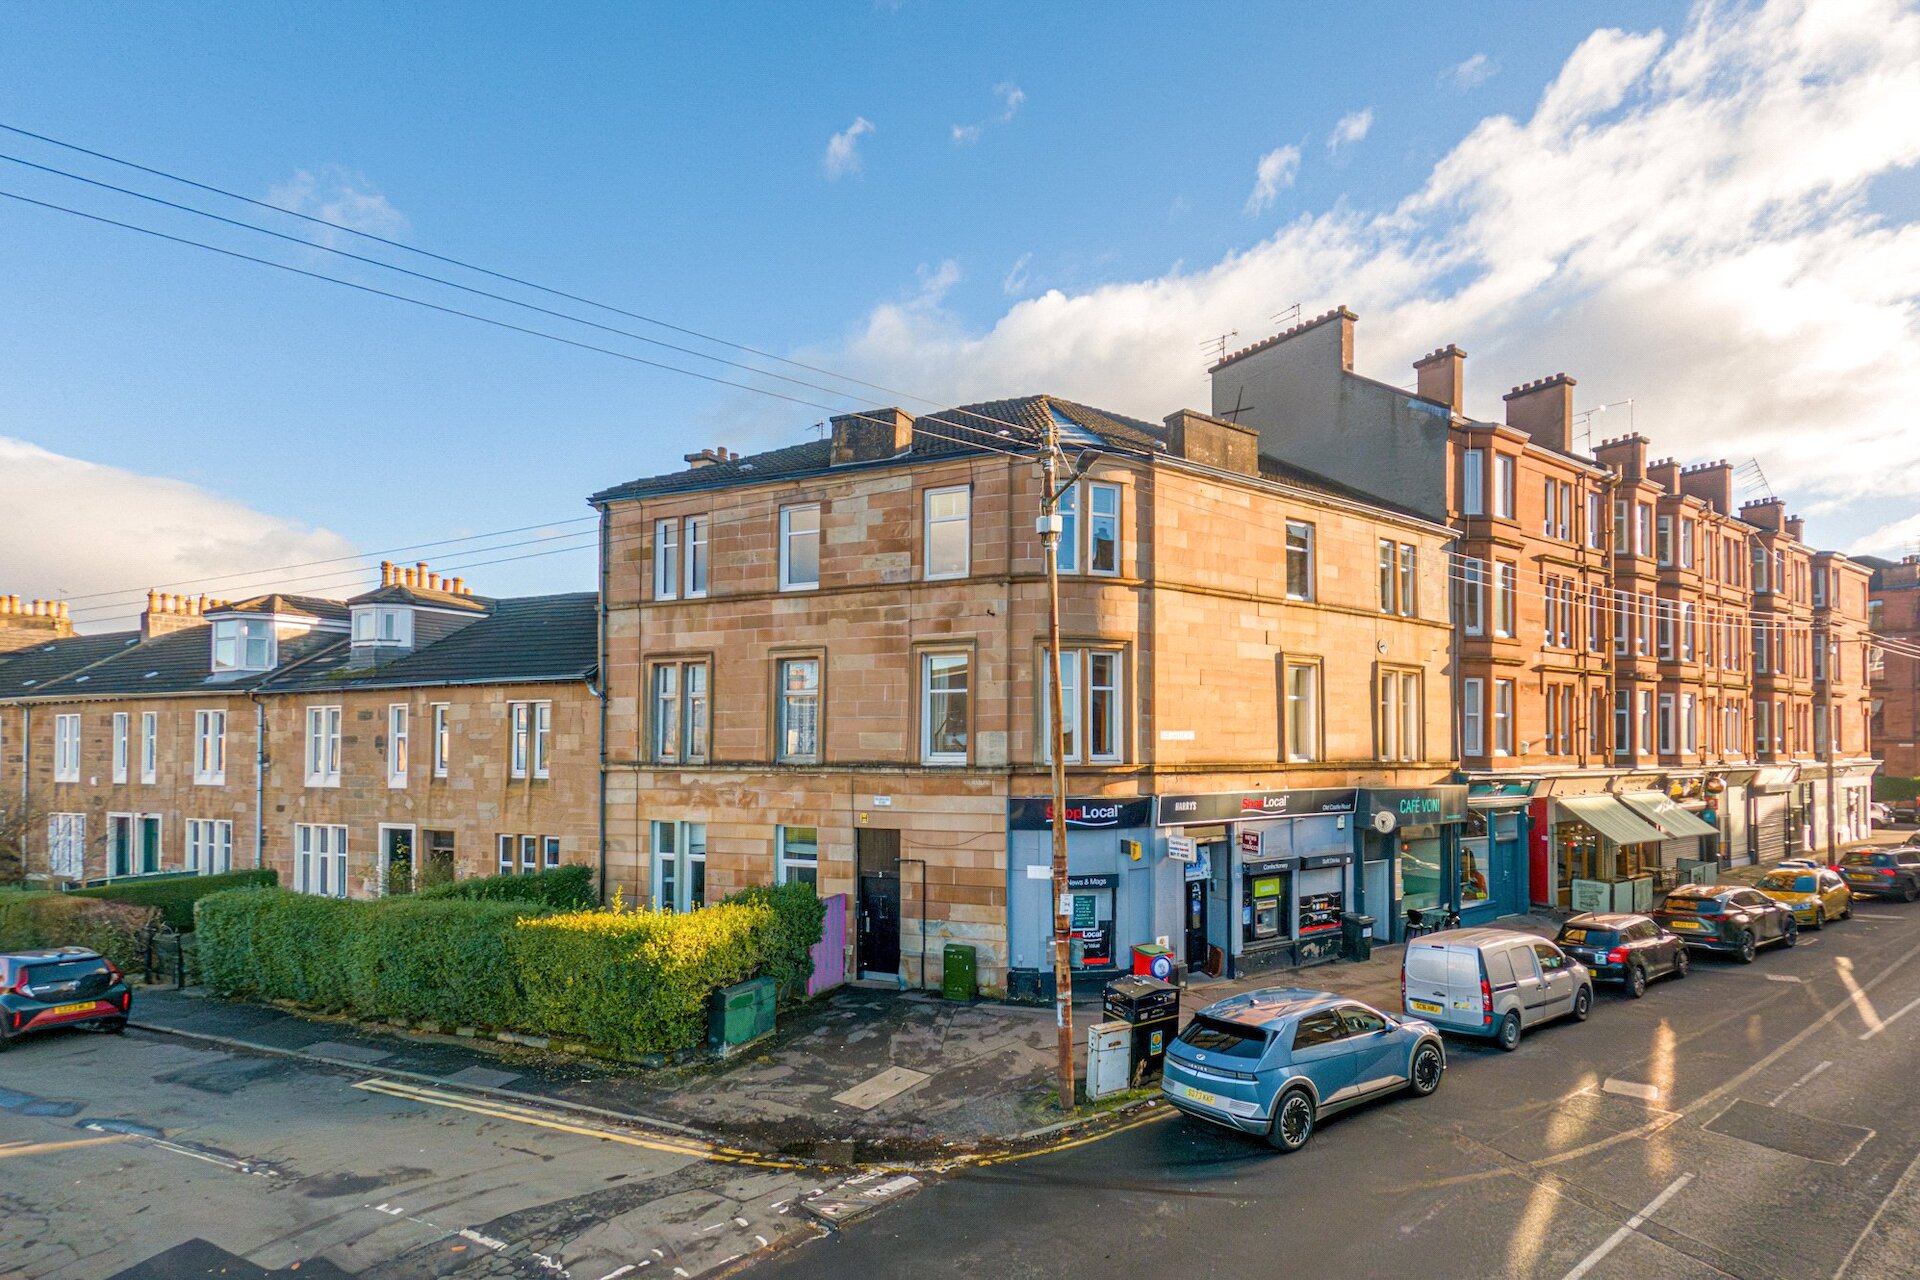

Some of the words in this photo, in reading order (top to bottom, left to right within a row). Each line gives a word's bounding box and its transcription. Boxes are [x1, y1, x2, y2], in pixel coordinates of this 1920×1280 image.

[1046, 804, 1118, 820] SopLocal
[1400, 796, 1420, 813] CAFÉ
[1421, 799, 1440, 812] VONI
